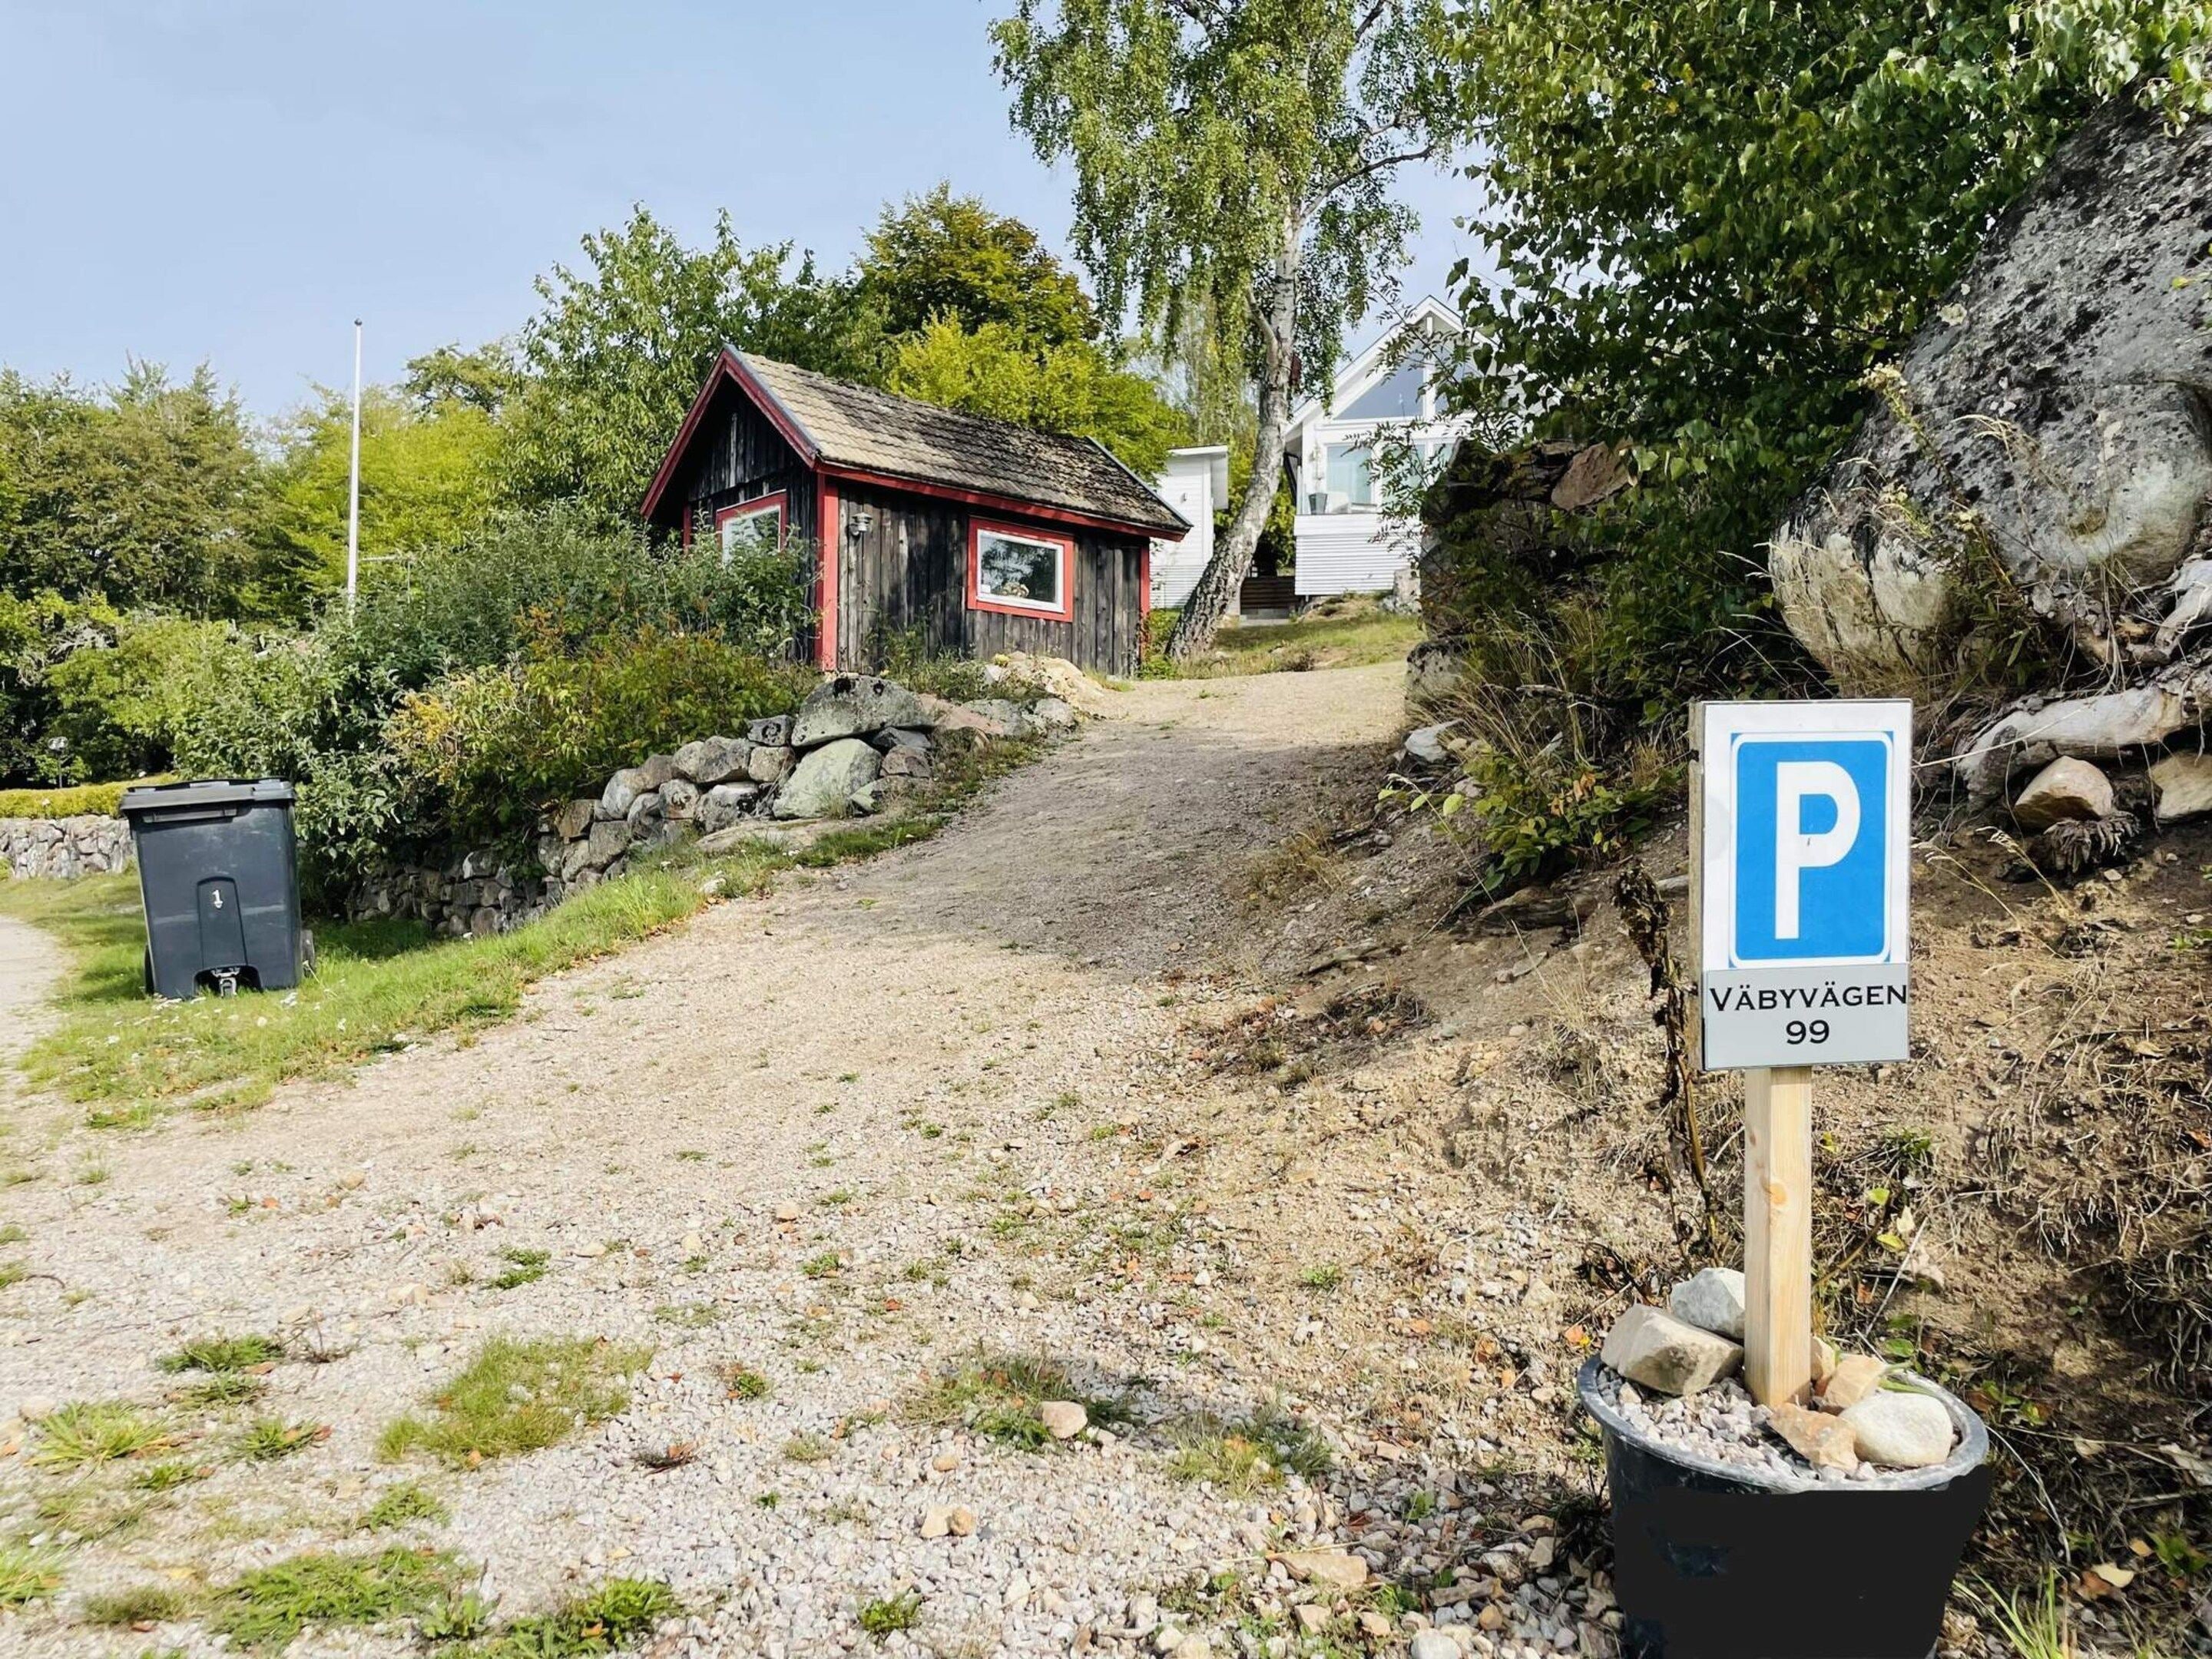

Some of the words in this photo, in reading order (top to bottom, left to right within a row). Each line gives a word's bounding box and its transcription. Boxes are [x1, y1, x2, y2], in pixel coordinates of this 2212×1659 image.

[1775, 760, 1861, 939] P
[1709, 981, 1907, 1012] VÄBYVÄGEN
[1785, 1019, 1830, 1045] 99
